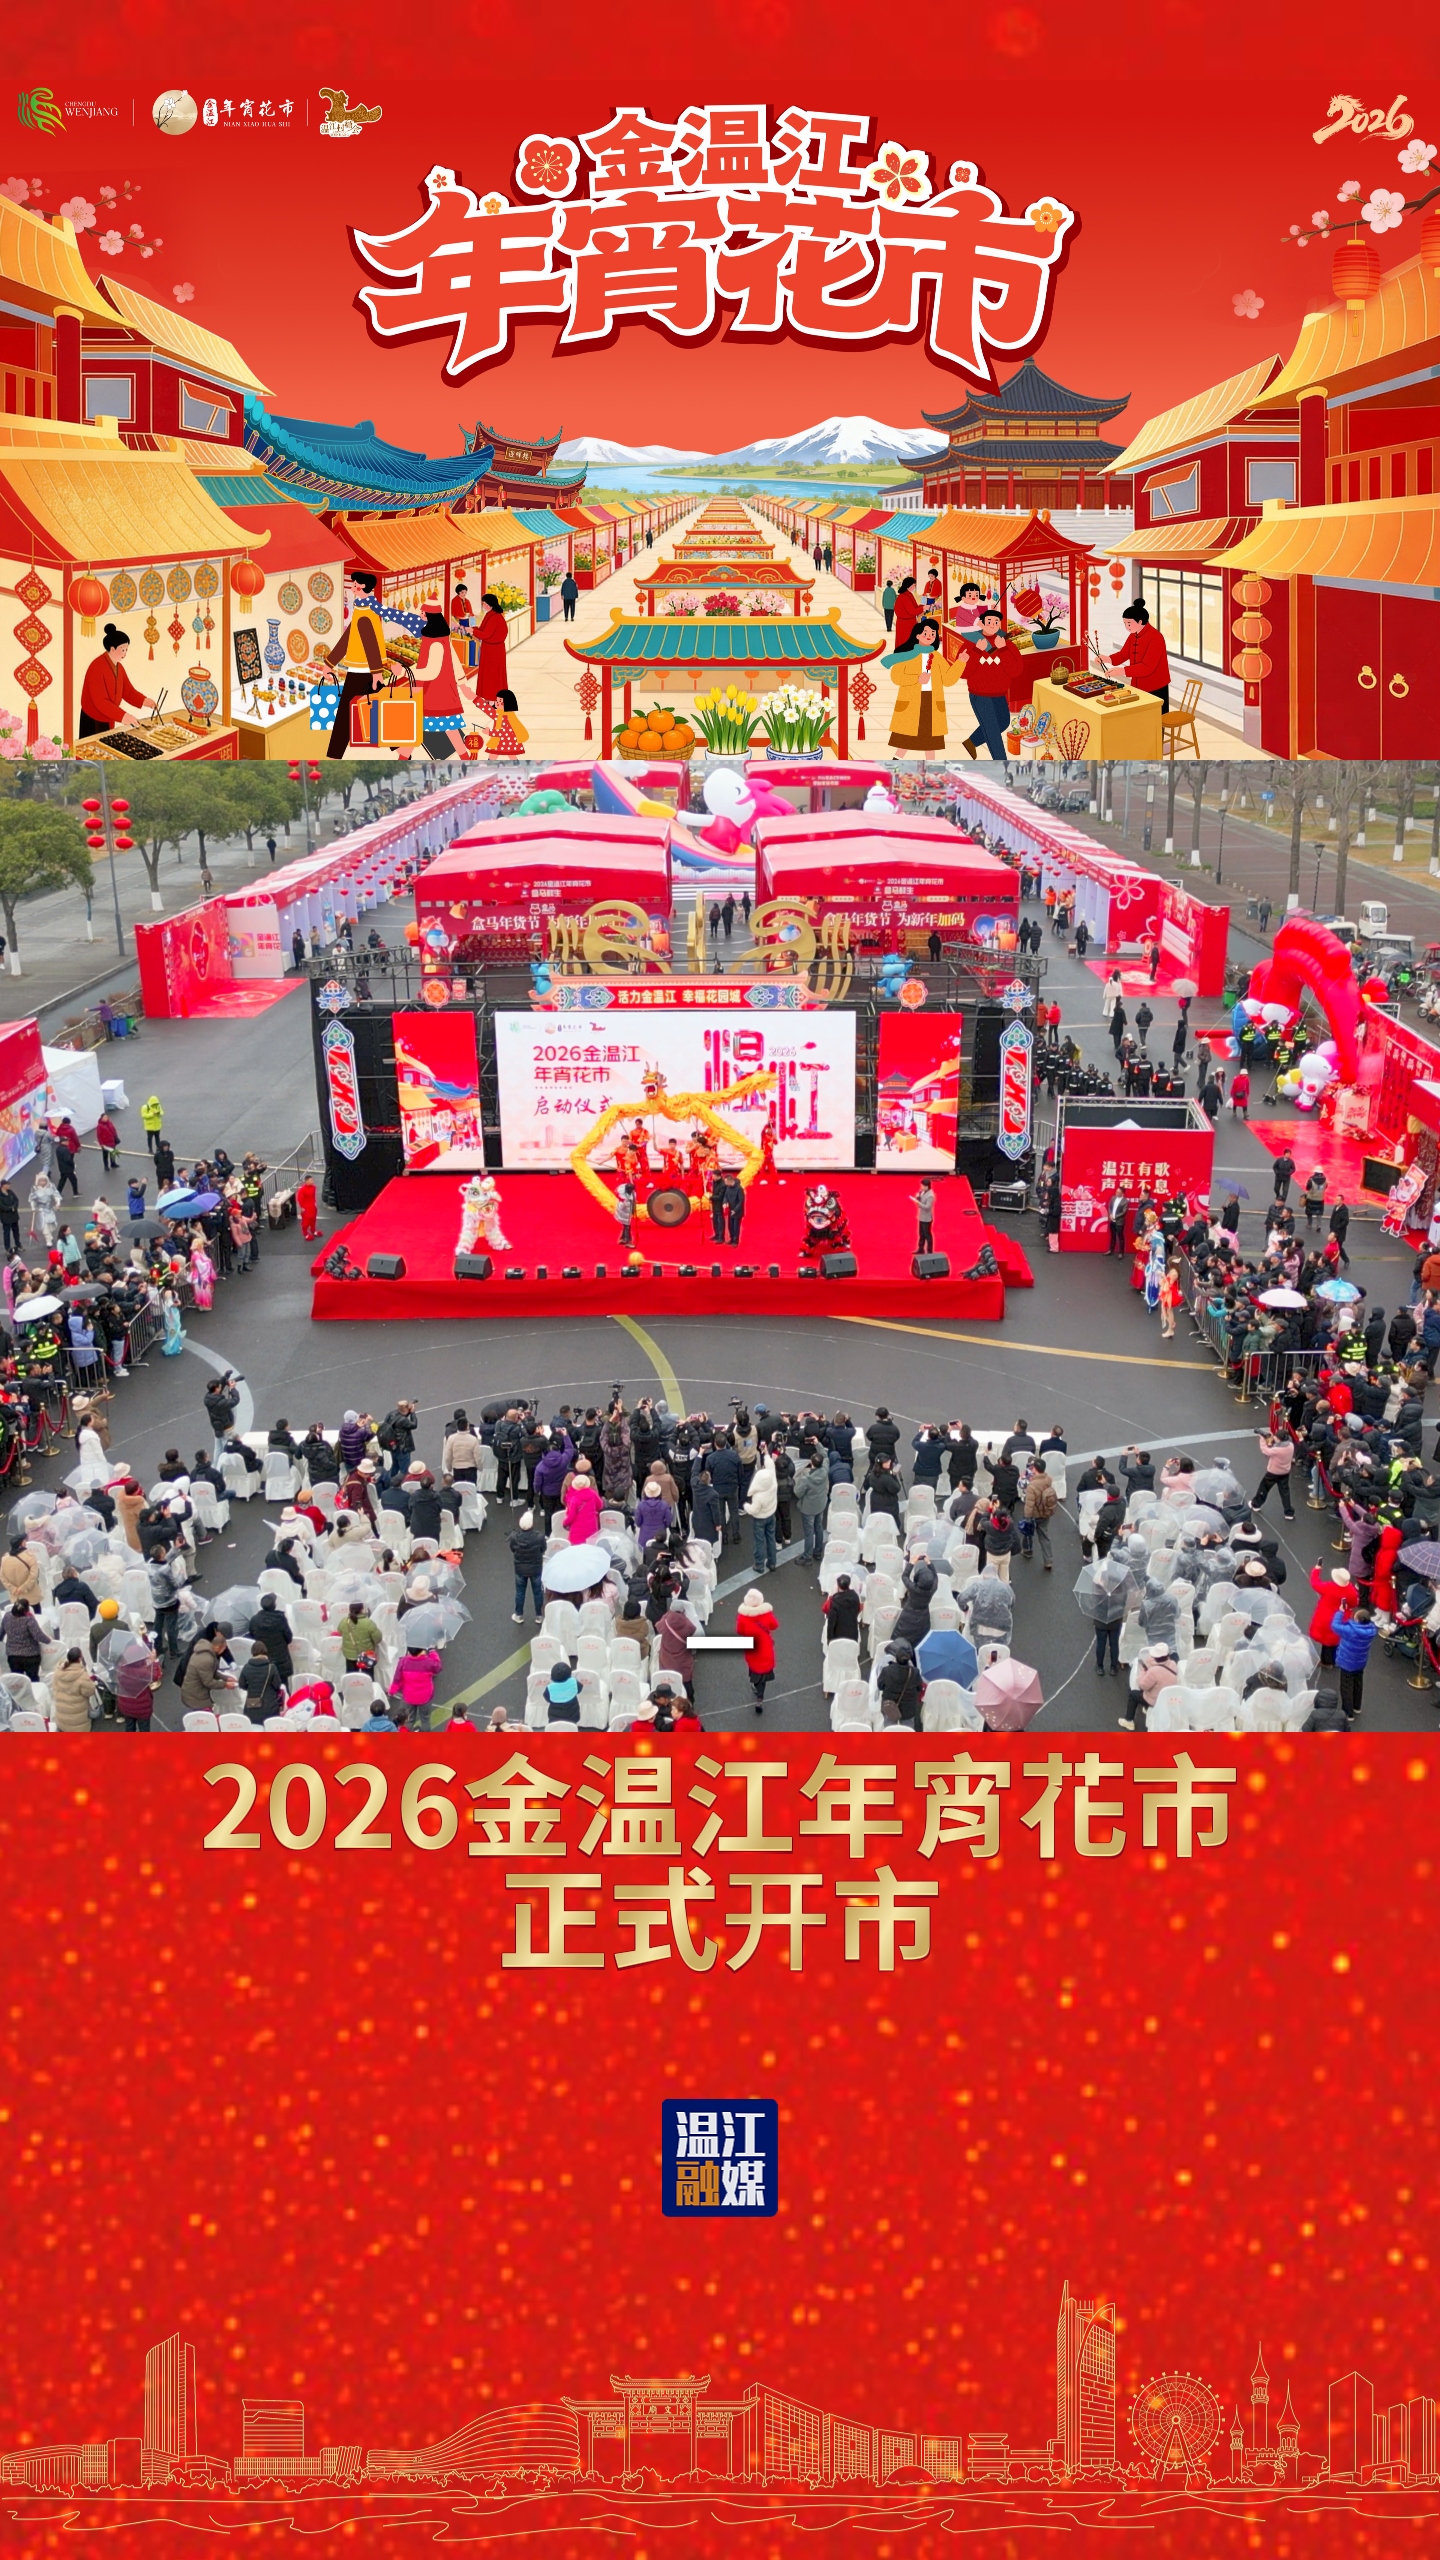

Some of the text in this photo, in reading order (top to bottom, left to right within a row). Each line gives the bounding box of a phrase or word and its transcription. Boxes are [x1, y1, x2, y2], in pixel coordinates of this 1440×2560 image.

[471, 914, 541, 931] 盒马年货节
[897, 911, 966, 928] 为新年加码
[617, 988, 742, 1005] 活力金温江 幸福花园城
[533, 1044, 641, 1063] 2026金温江
[768, 1046, 797, 1057] 2026
[533, 1065, 611, 1084] 年宵花市
[533, 1094, 614, 1117] 启动仪式
[1102, 1161, 1170, 1177] 温江有歌
[1101, 1178, 1169, 1194] 声声不息
